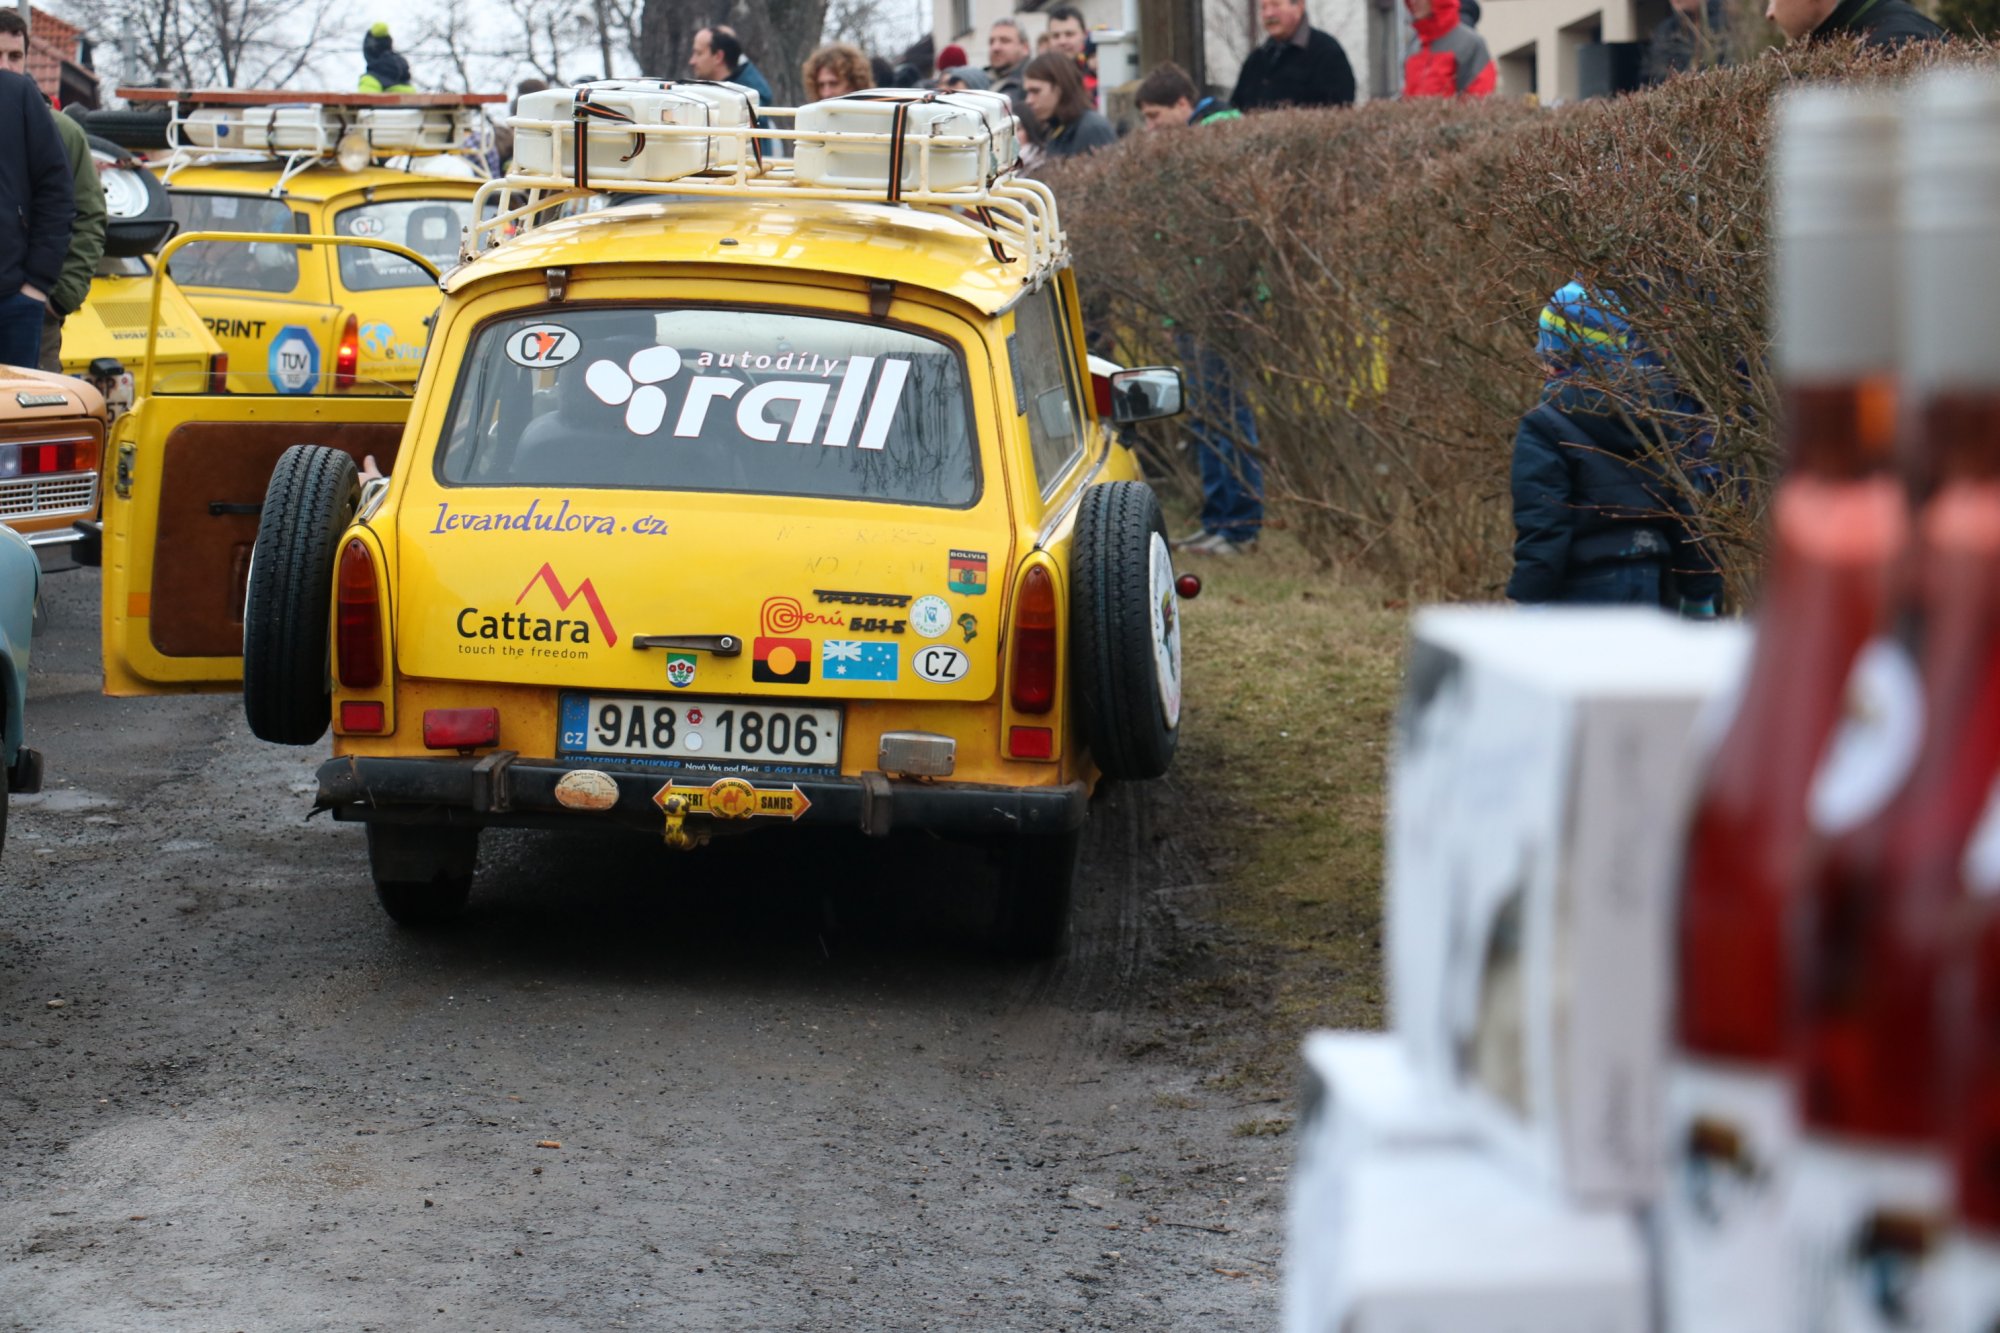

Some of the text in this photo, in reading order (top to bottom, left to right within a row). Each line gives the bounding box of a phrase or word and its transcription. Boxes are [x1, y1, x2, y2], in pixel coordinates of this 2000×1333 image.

[202, 318, 267, 339] PRINT
[520, 331, 566, 362] CZ
[697, 351, 839, 378] autodíly
[673, 355, 912, 450] rall
[430, 498, 669, 536] levandulova.cz
[950, 551, 987, 560] BOLIVIA
[456, 607, 590, 644] Cattara
[760, 595, 845, 638] Perú
[458, 643, 589, 659] touch the freedom
[925, 650, 958, 678] CZ
[563, 731, 584, 746] CZ
[598, 704, 819, 757] 9A8 1806
[760, 796, 794, 810] SANDS
